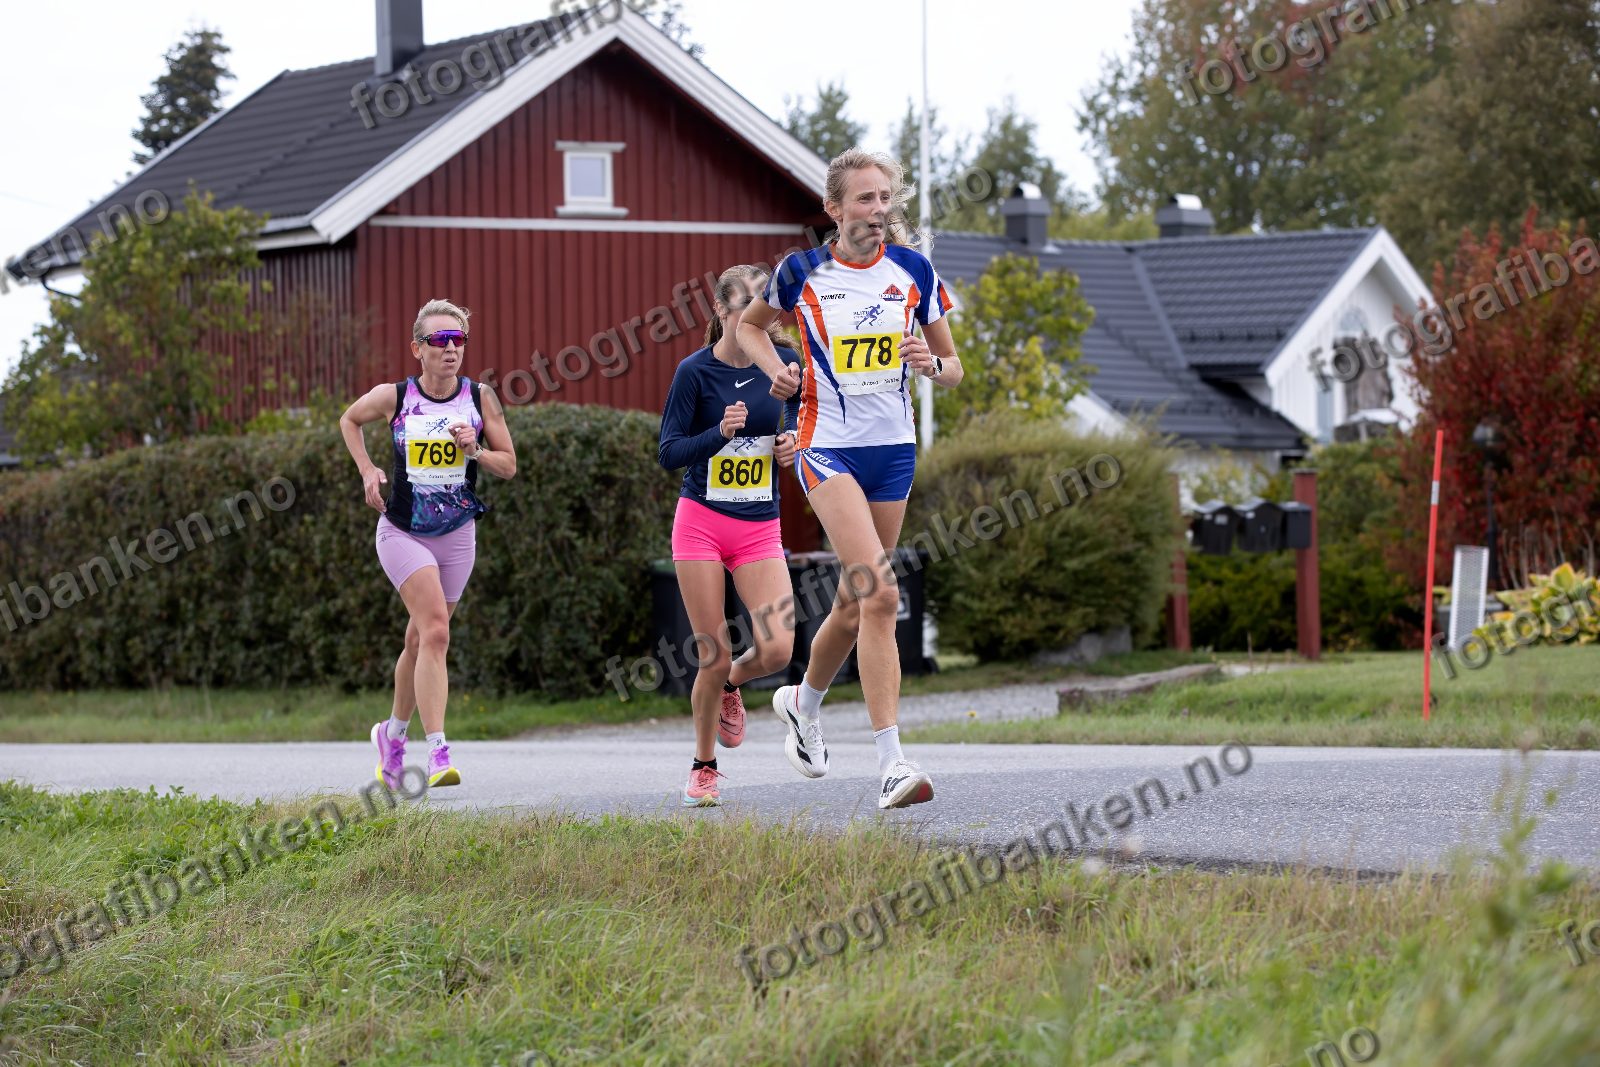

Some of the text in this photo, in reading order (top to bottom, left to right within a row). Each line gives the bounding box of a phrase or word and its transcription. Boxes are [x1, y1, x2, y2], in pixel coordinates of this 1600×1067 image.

[820, 293, 846, 301] TRIMTEX
[841, 336, 892, 368] 778
[414, 441, 457, 466] 769
[718, 458, 763, 486] 860
